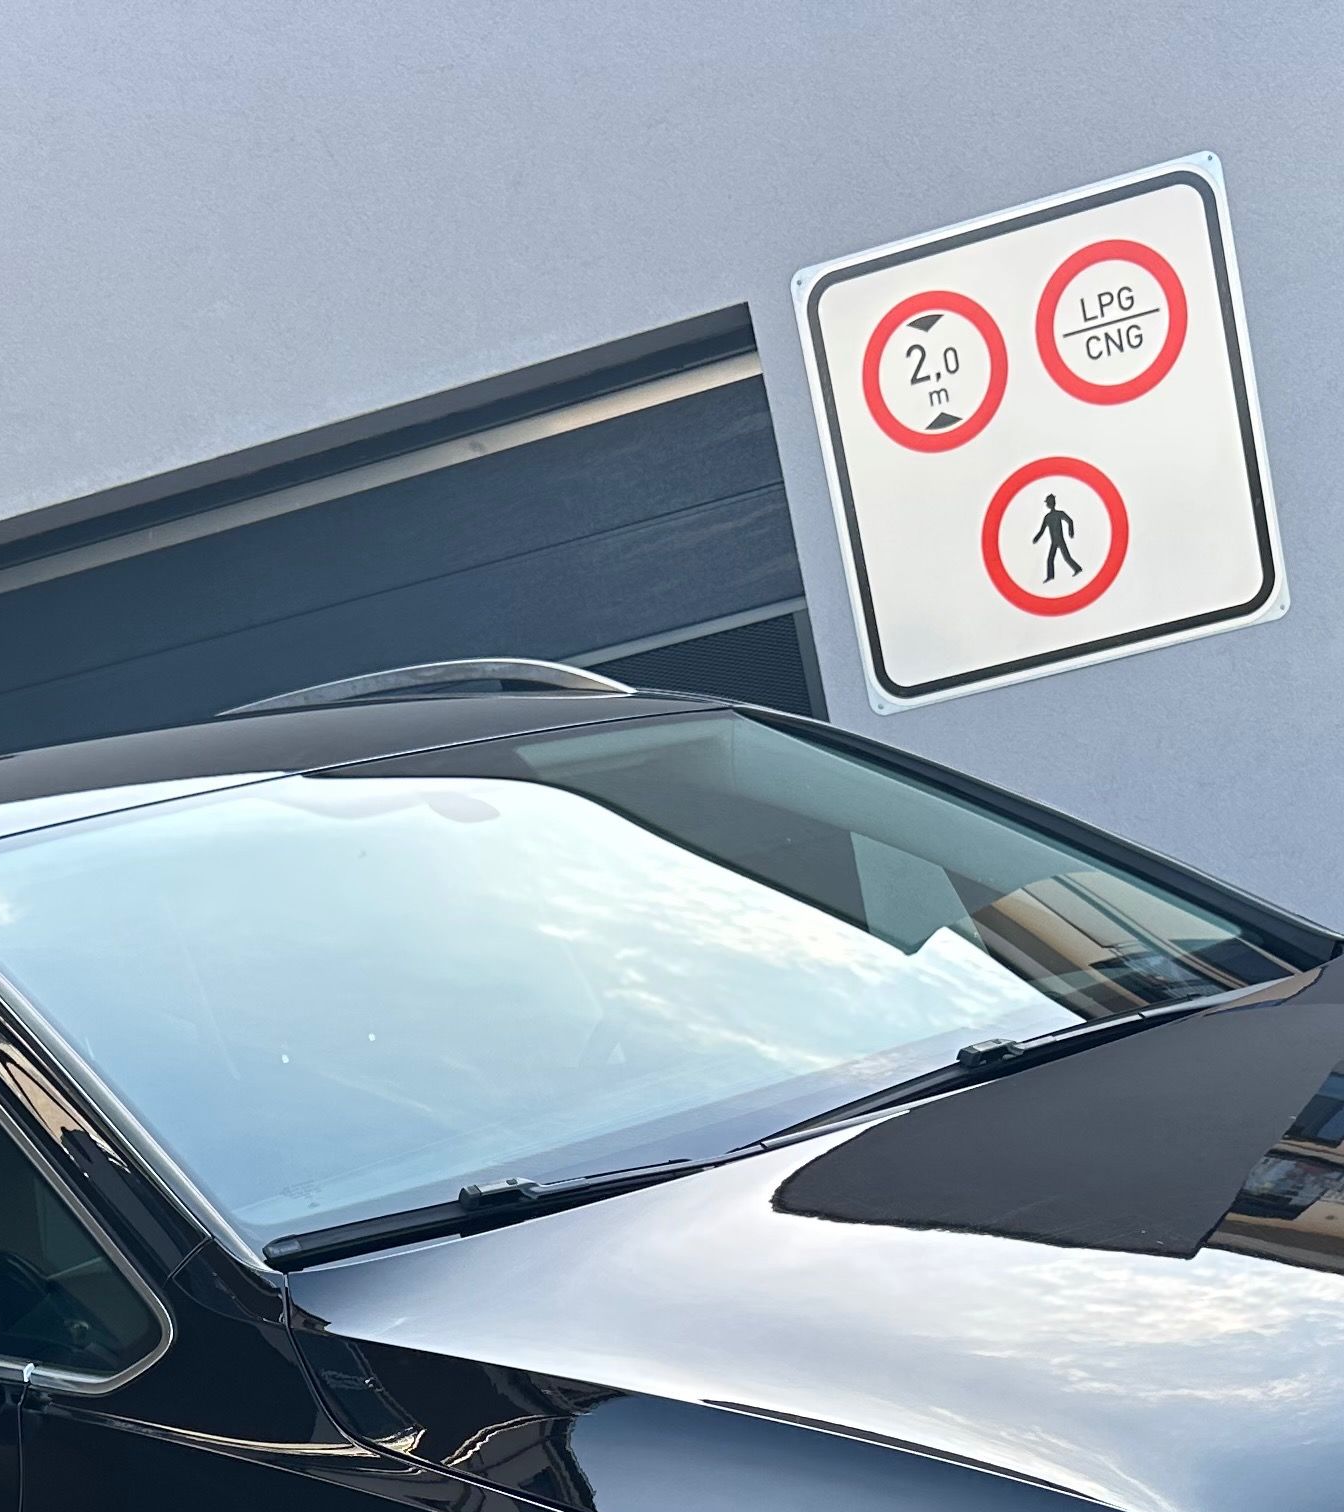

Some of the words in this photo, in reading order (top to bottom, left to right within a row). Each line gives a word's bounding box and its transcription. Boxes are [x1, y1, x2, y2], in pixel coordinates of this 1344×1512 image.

[1080, 286, 1134, 322] LPG
[1086, 324, 1143, 360] CNG
[906, 343, 959, 385] 2,0
[928, 387, 950, 407] m
